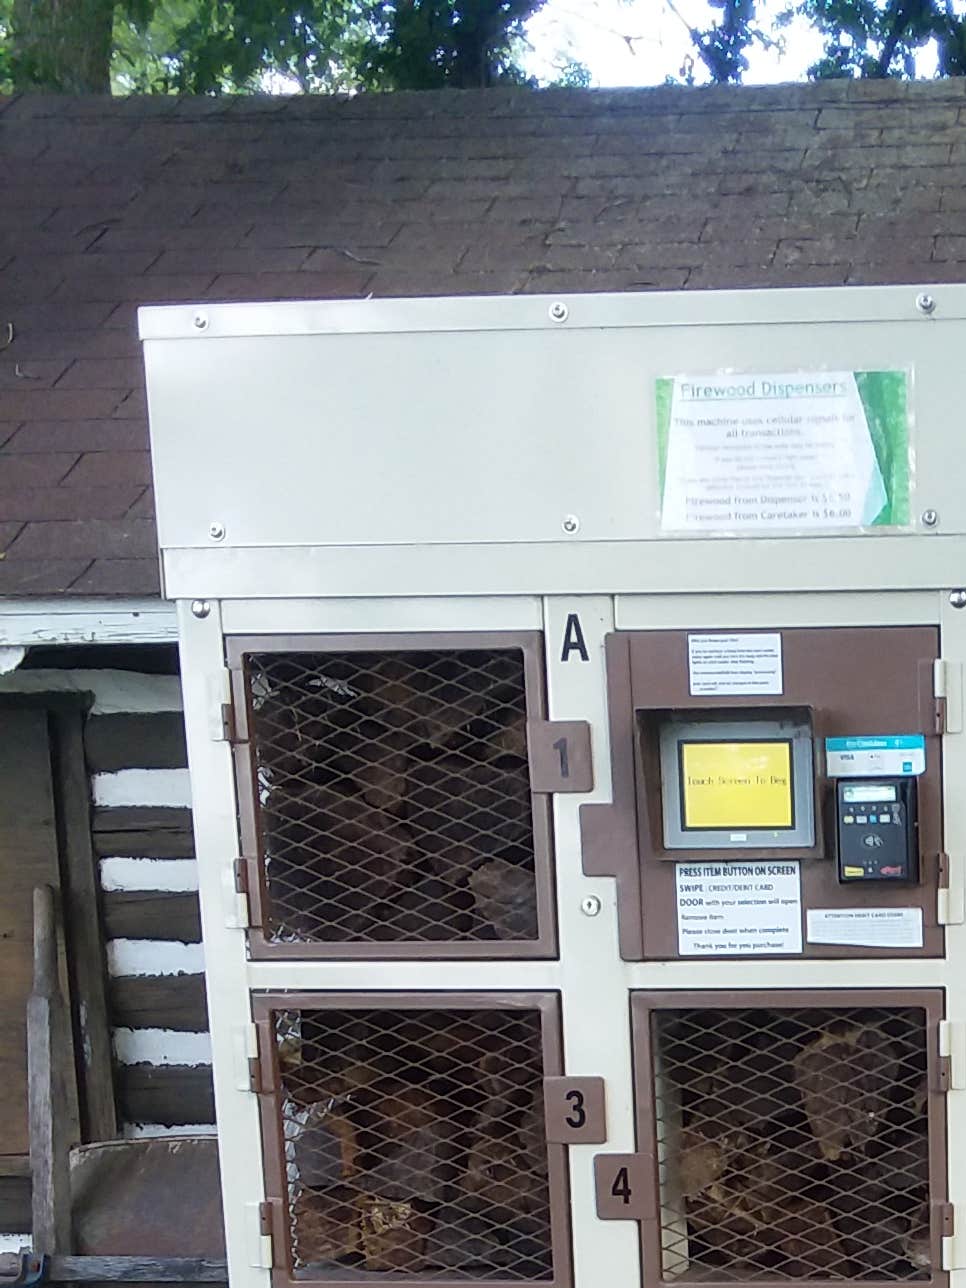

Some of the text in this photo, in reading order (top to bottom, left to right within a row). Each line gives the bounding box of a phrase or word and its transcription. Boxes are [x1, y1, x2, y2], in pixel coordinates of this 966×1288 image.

[680, 380, 847, 398] Firewood Dispensers
[697, 415, 738, 426] machine
[766, 415, 802, 425] cellular
[685, 496, 731, 505] Firewood
[735, 495, 758, 505] from
[760, 494, 807, 506] Dispenser
[686, 511, 731, 521] Firewood
[735, 510, 758, 520] from
[760, 509, 808, 520] Caretaker
[561, 614, 590, 662] A
[553, 737, 569, 778] 1
[680, 865, 796, 877] PRESS ITEM BUTTON ON SCREEN
[679, 884, 703, 892] SWIPE
[680, 898, 704, 906] DOOR
[565, 1090, 586, 1128] 3
[611, 1167, 632, 1204] 4
